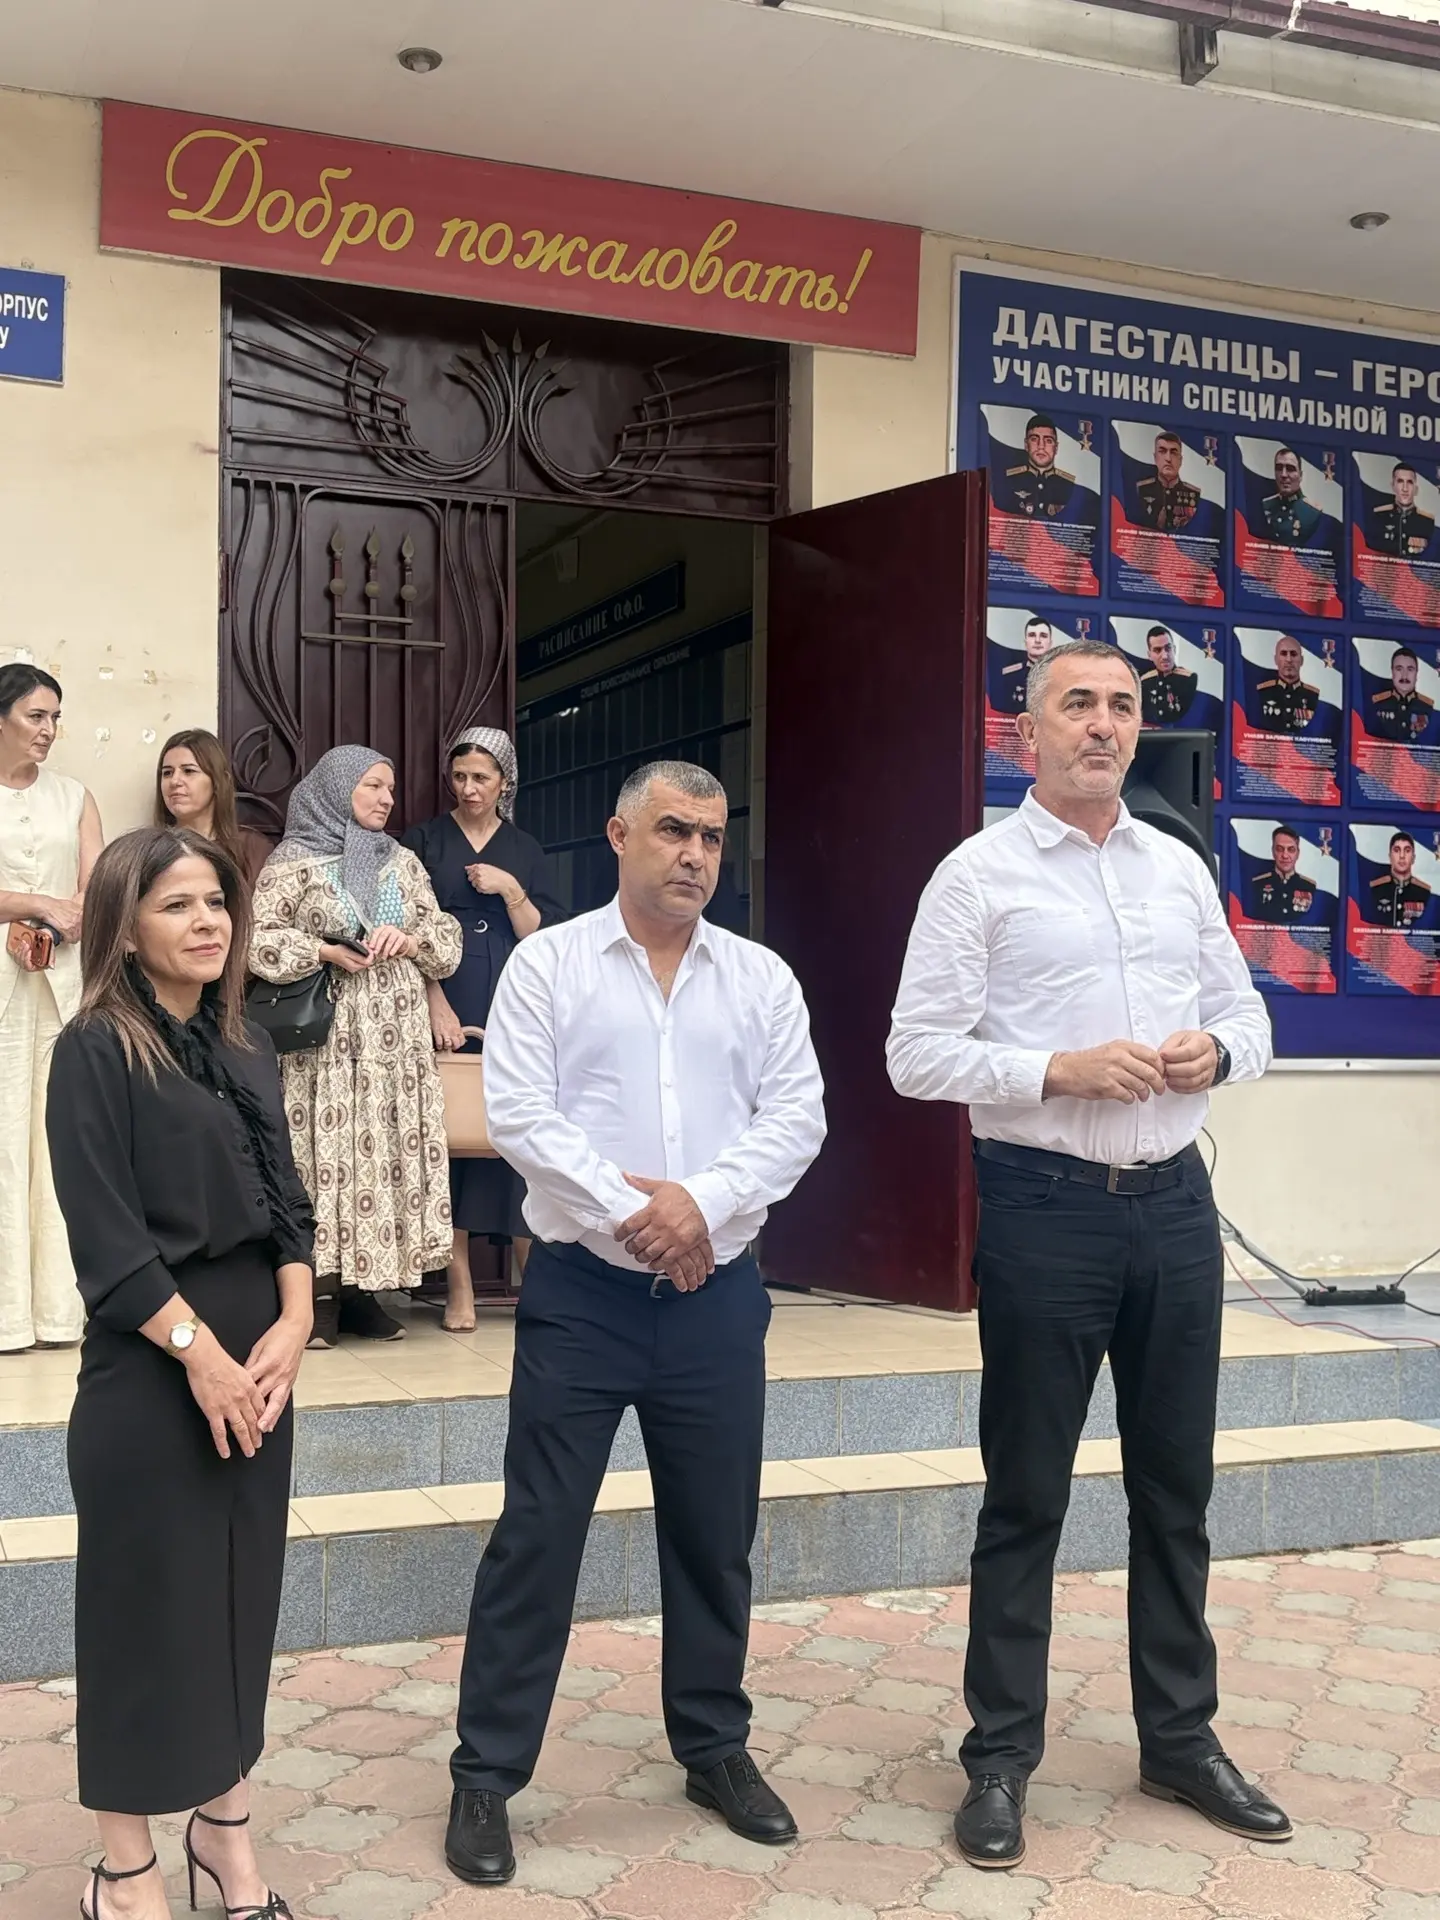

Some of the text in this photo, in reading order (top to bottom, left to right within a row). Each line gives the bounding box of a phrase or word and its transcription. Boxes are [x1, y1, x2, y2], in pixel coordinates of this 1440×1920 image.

[166, 129, 873, 315] Добро пожаловать!
[0, 293, 49, 322] РПУС
[992, 306, 1300, 384] ДАГЕСТАНЦЫ
[992, 357, 1440, 443] УЧАСТНИКИ СПЕЦИАЛЬНОЙ ВО
[538, 608, 608, 659] РАСПИСАНИЕ
